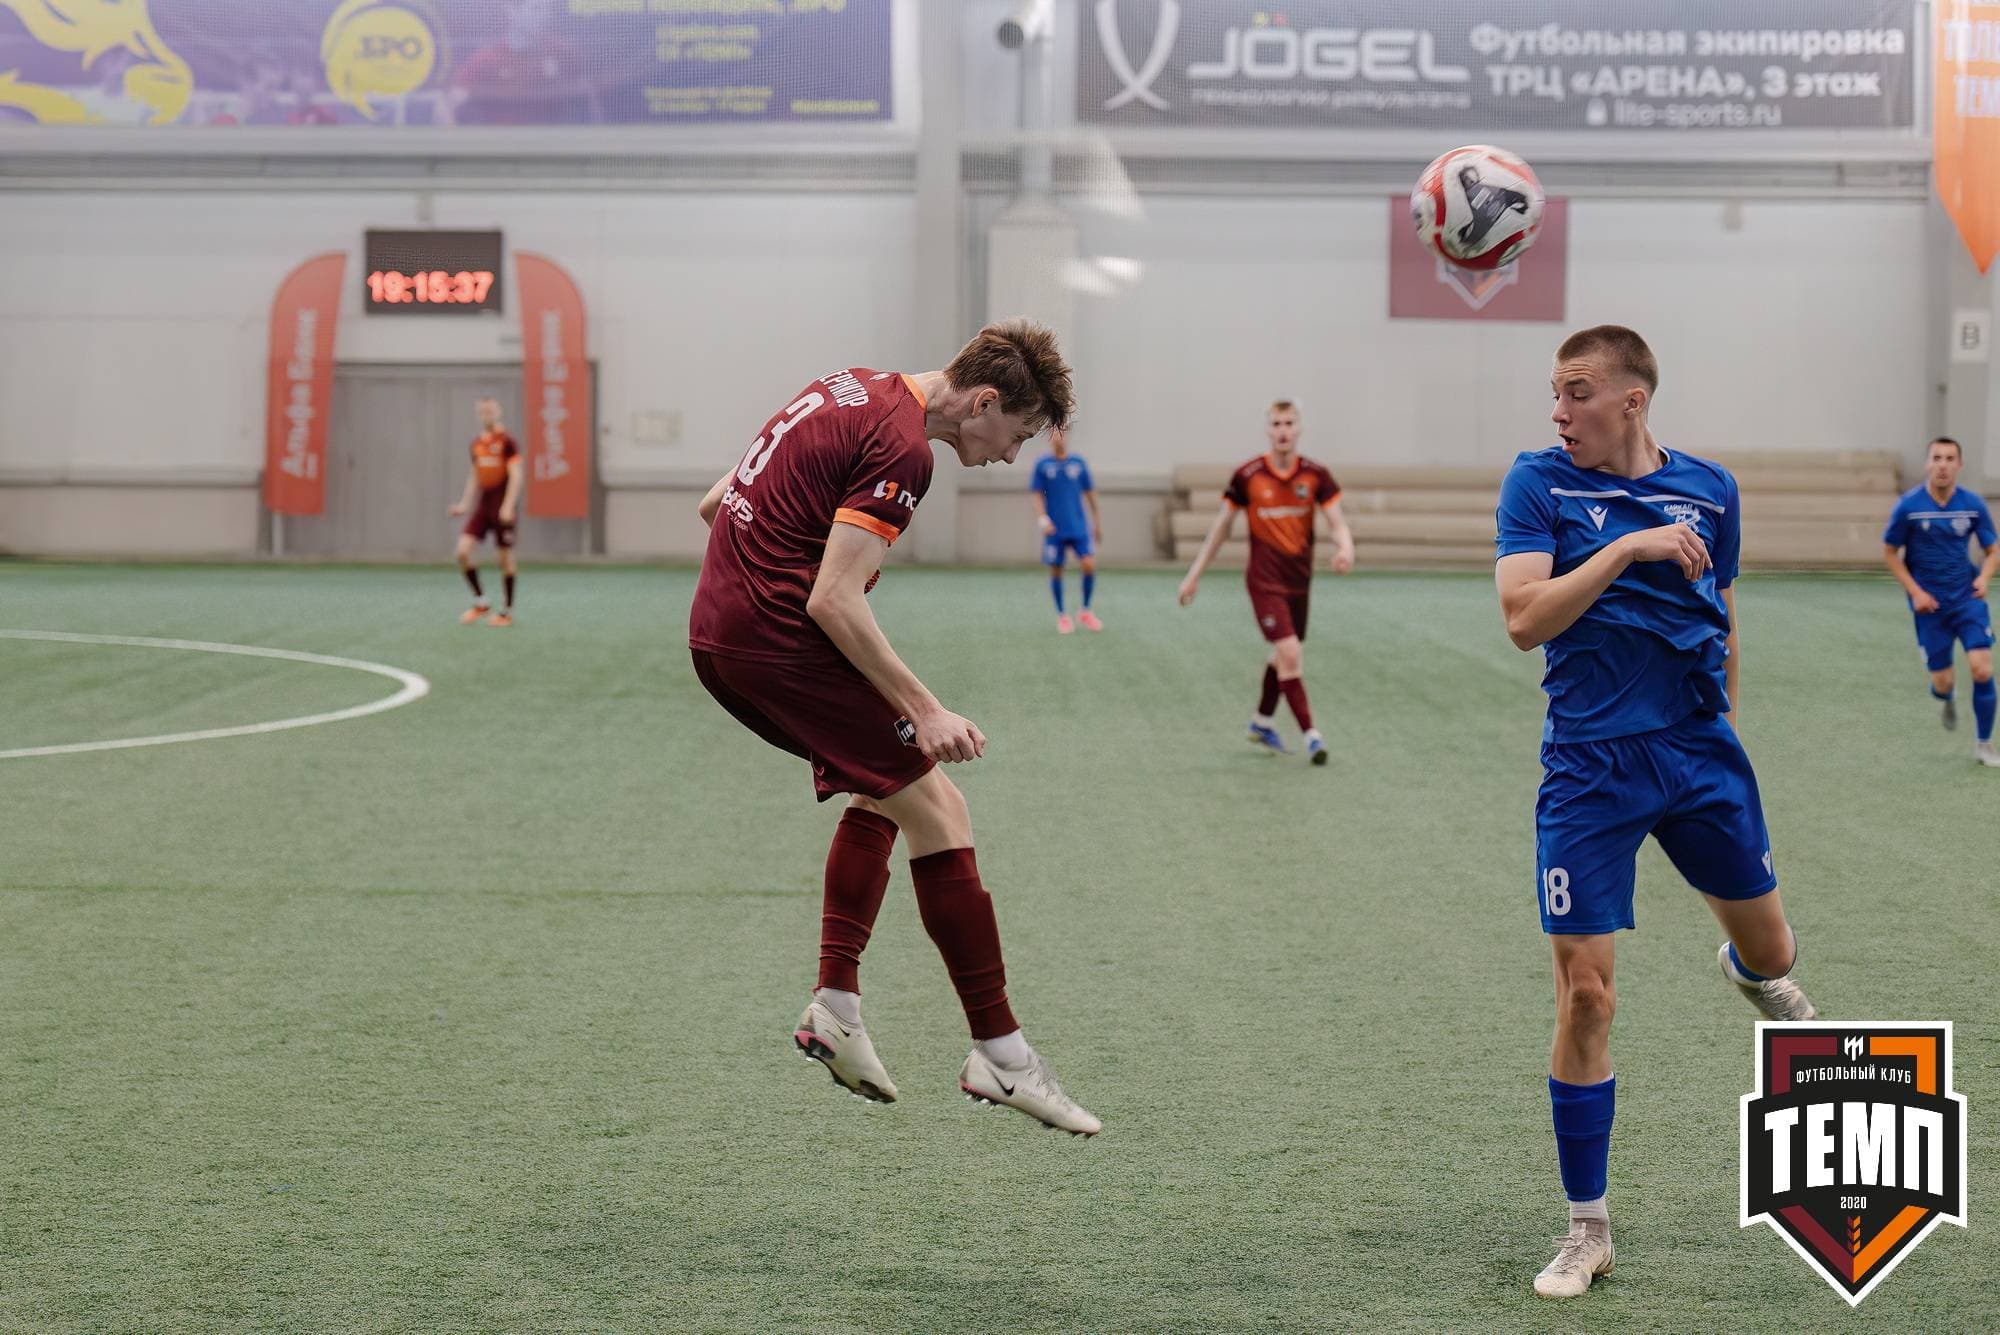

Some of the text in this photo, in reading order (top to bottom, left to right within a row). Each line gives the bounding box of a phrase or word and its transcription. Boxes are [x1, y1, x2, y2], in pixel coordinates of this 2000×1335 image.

[1469, 23, 1905, 62] Футбольная экипировка
[1486, 66, 1881, 100] ТРЦ «АРЕНА», 3 этаж
[1615, 101, 1782, 127] lite-sports.ru
[816, 369, 869, 407] ЕРНИГОР
[737, 391, 825, 486] 3
[1542, 867, 1572, 916] 18
